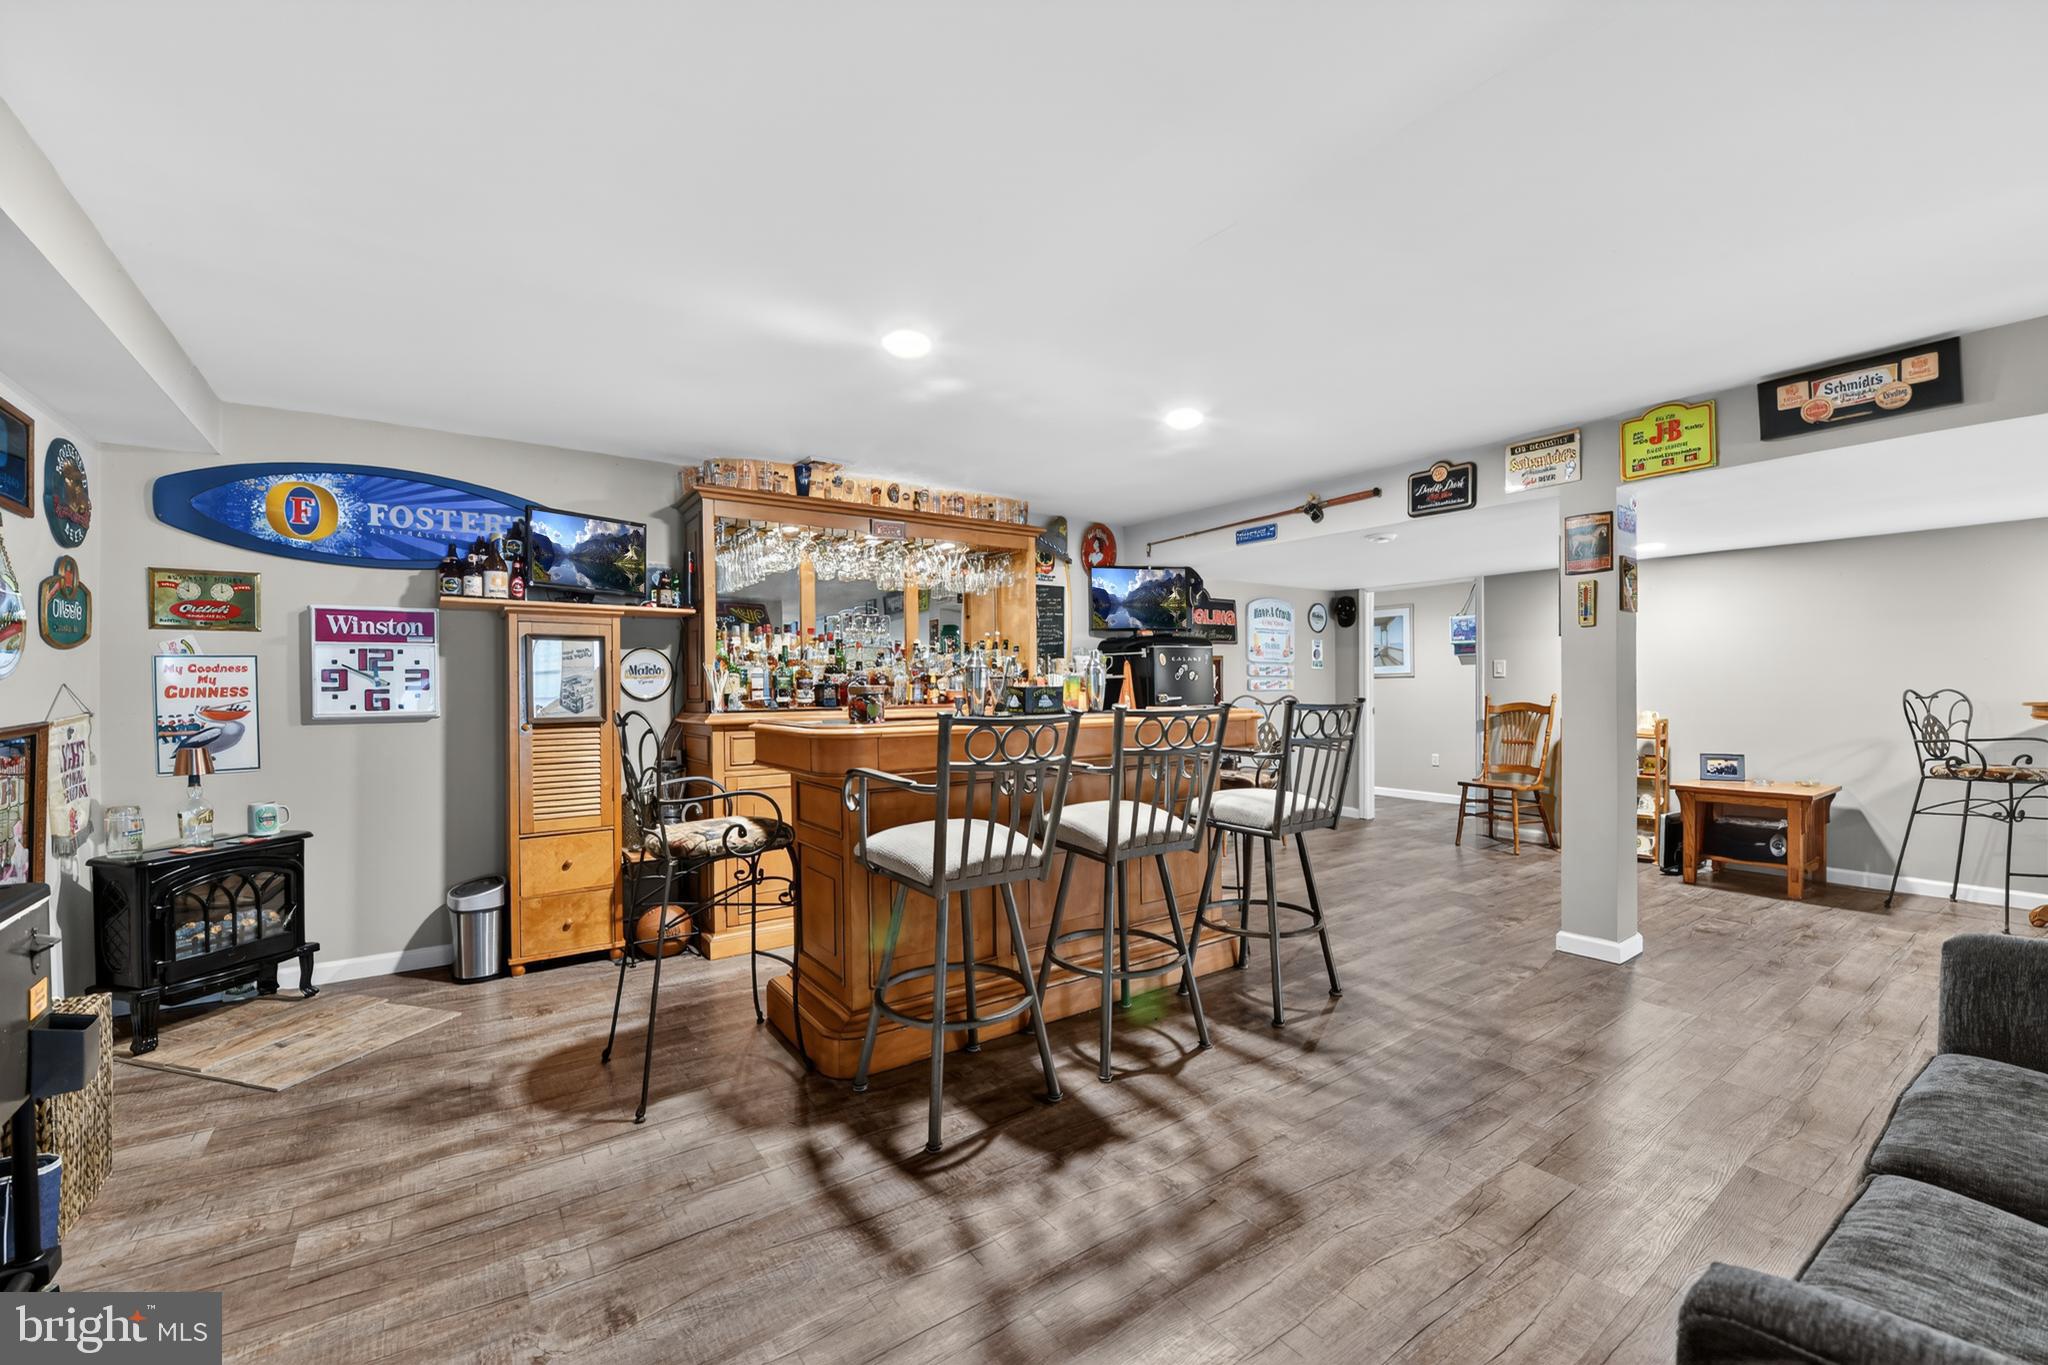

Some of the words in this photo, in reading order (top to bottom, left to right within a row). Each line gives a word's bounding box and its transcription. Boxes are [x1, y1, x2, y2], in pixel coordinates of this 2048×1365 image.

[1824, 373, 1884, 396] Schmidt's
[289, 496, 315, 524] F
[326, 613, 424, 636] Winston
[163, 664, 183, 675] My
[187, 663, 248, 673] Goodness
[197, 675, 216, 686] My
[164, 685, 249, 699] GUINNESS
